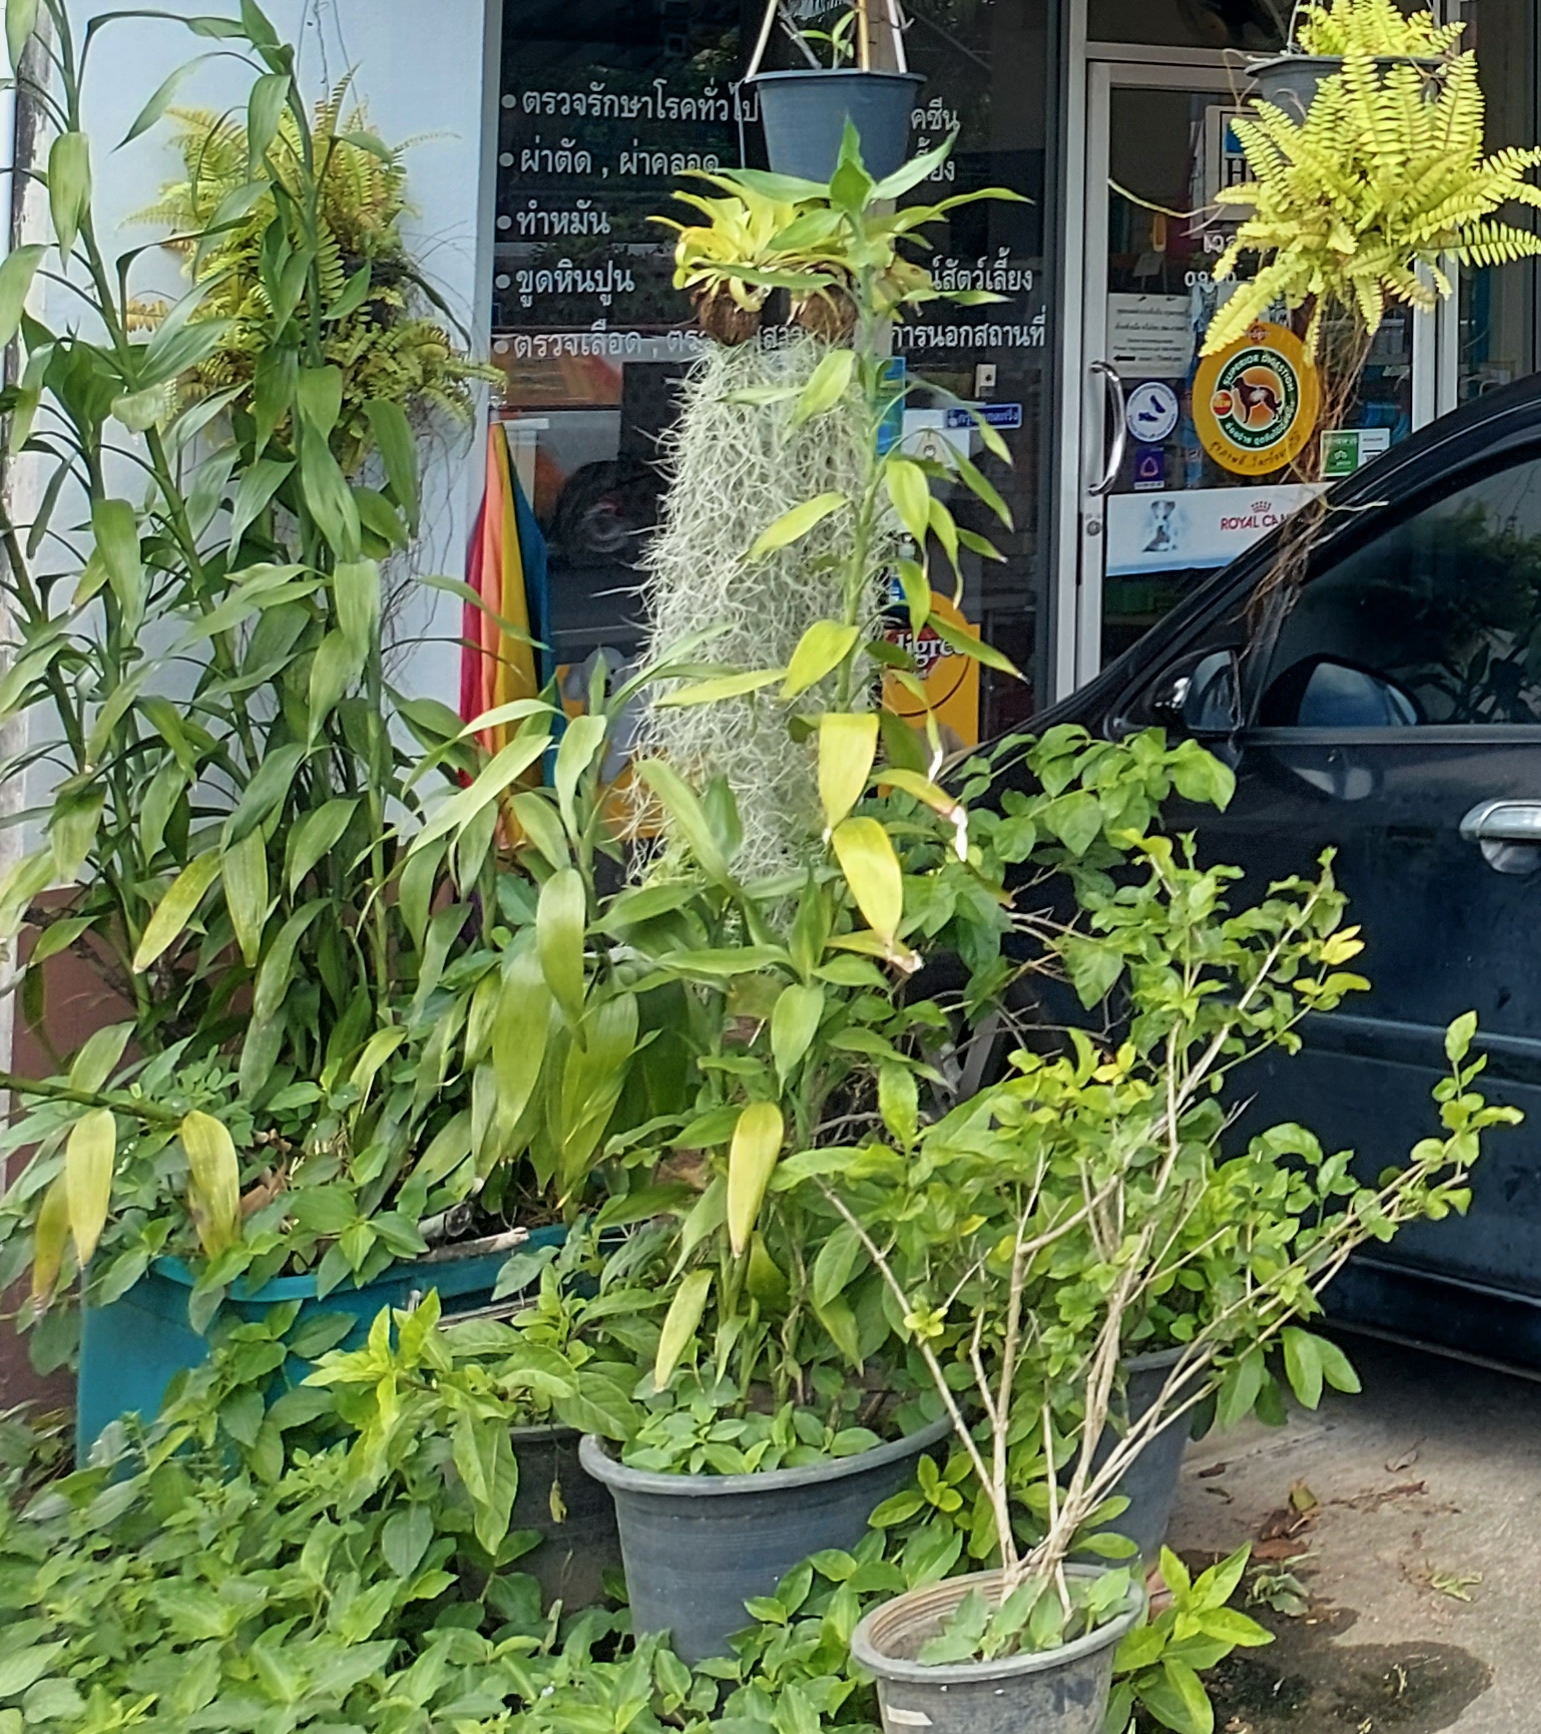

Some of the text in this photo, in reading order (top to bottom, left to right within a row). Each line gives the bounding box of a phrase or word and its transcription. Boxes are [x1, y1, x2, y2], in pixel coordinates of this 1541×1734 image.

[522, 77, 759, 122] ตรวจรักษาโรคทั่วไป
[520, 136, 592, 174] ผ่าตัด
[516, 200, 611, 235] ทำหมัน
[516, 259, 635, 308] ขูดหินปูน
[514, 319, 641, 358] ตรวจเลือด
[1220, 516, 1260, 531] ROYAL
